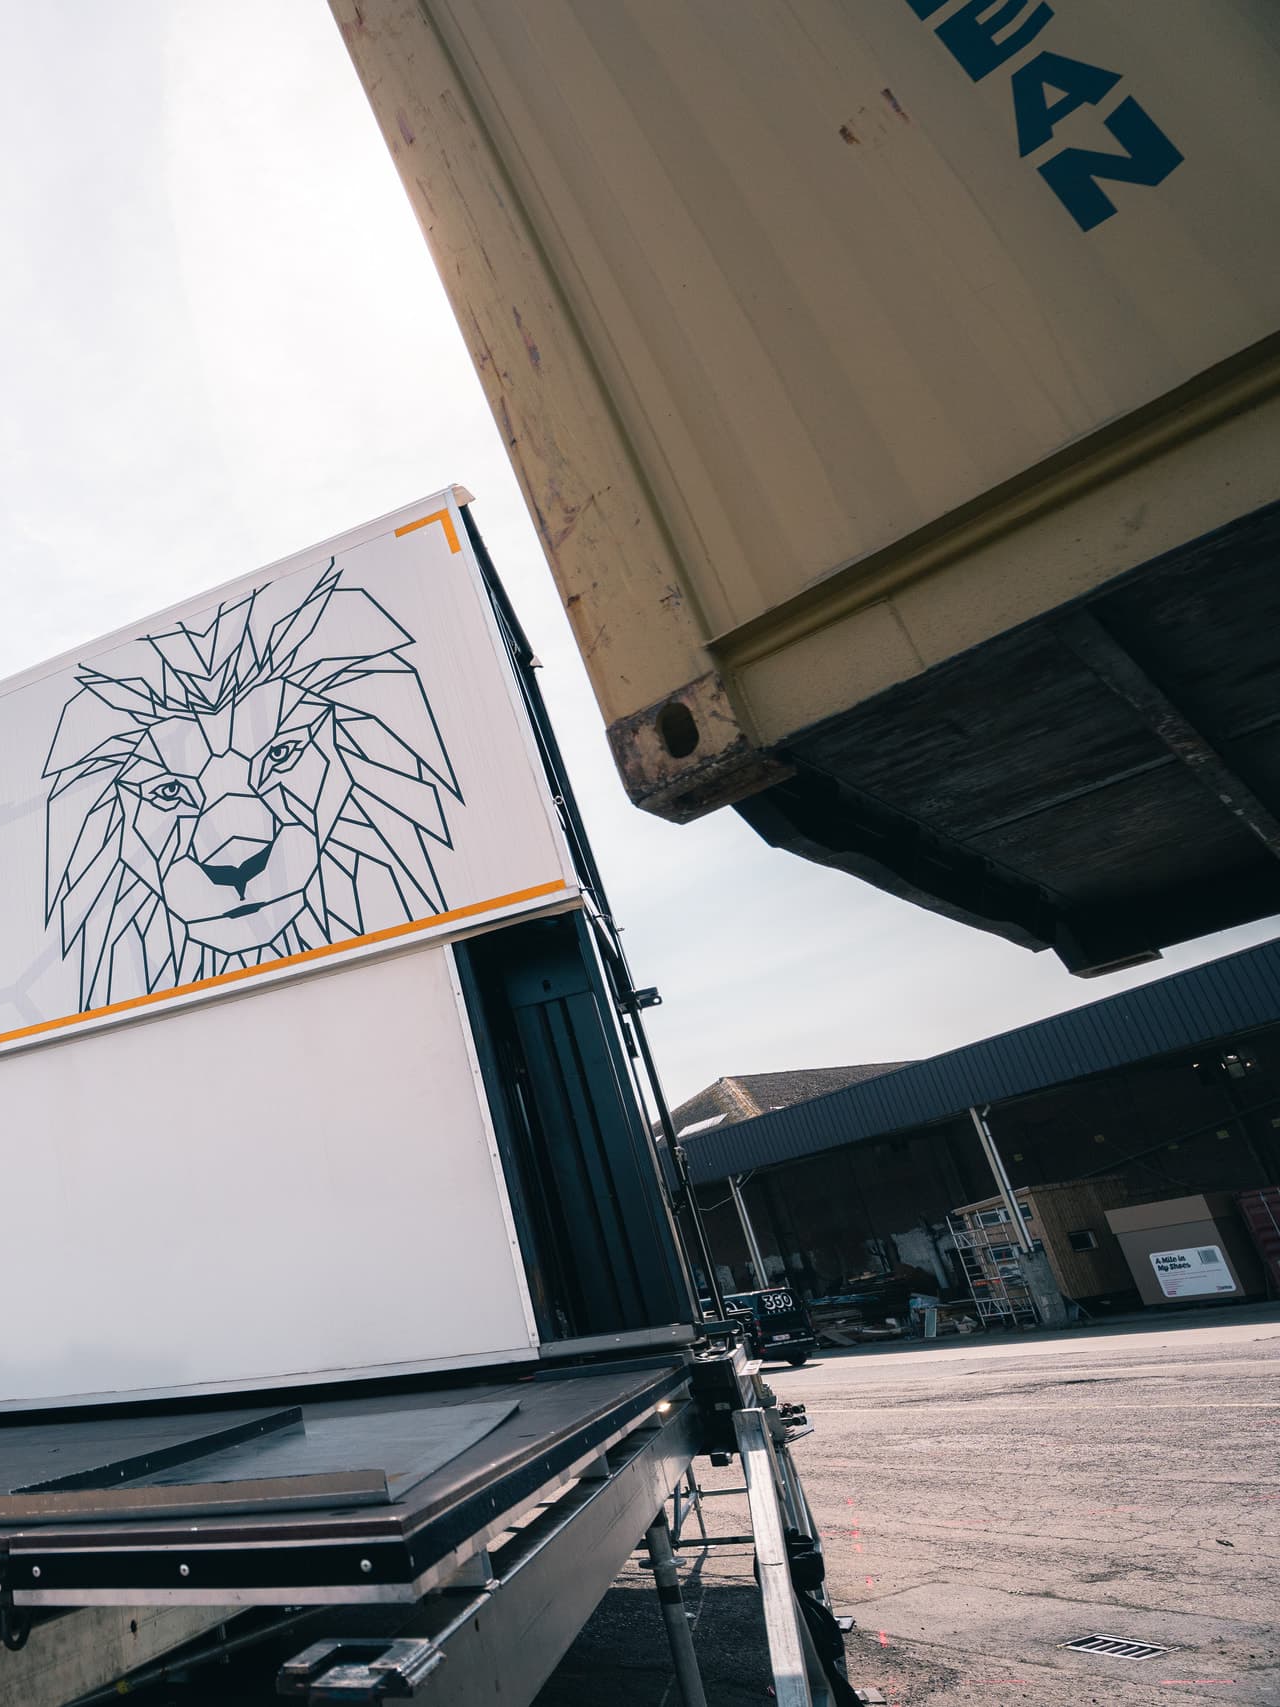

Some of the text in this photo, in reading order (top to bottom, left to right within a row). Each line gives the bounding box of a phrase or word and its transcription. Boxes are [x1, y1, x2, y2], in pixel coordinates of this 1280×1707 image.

[1161, 1255, 1177, 1263] Mile
[1157, 1262, 1191, 1272] My Shoes
[761, 1292, 793, 1310] 360
